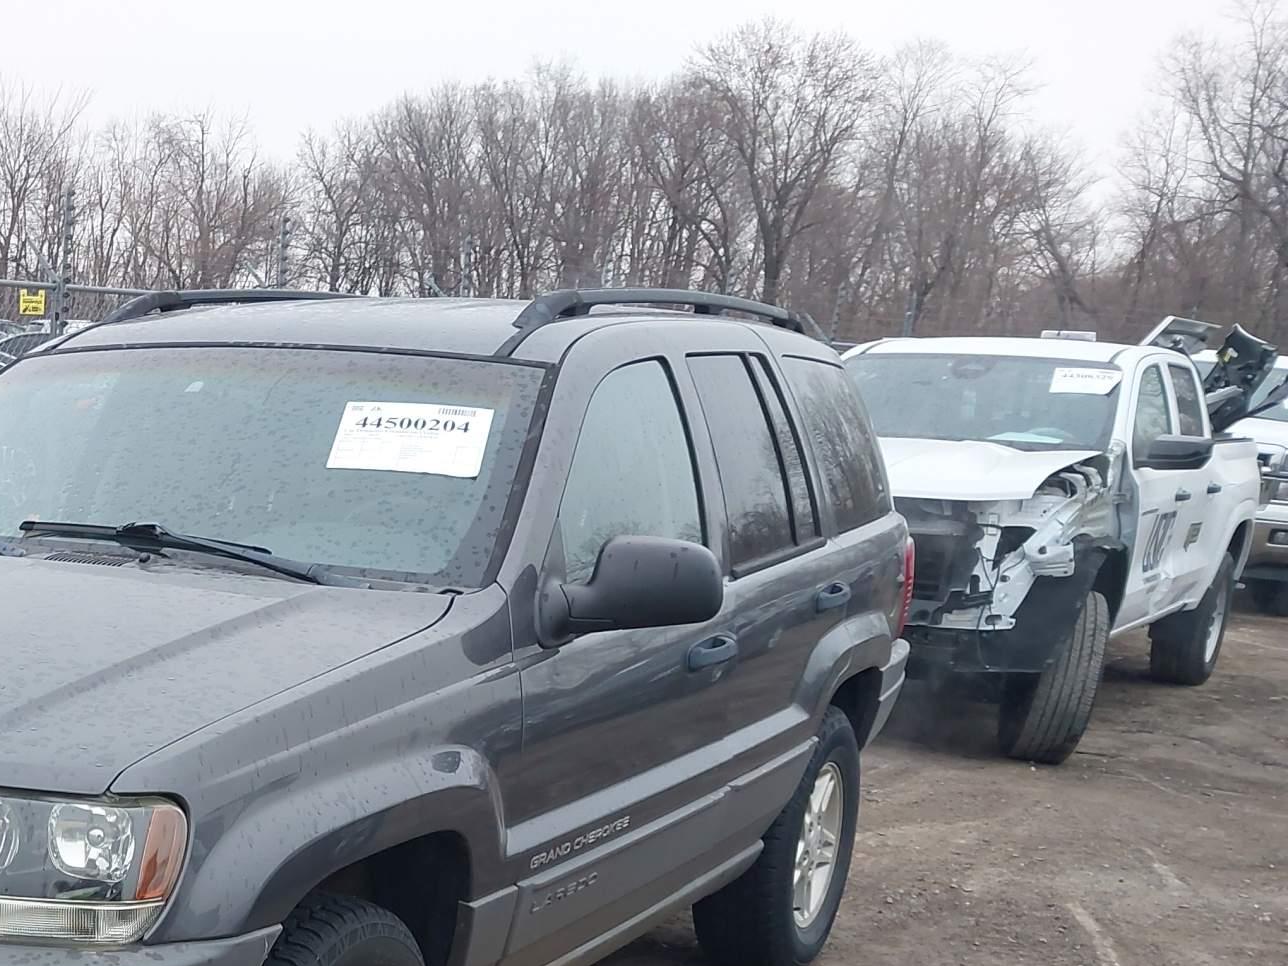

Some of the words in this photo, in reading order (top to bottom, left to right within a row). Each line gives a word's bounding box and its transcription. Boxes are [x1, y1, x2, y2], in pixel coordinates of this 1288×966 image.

[355, 416, 470, 433] 44500204
[530, 842, 571, 869] GRAND
[573, 815, 631, 851] CHEROKEE
[530, 871, 599, 914] LAREDO
